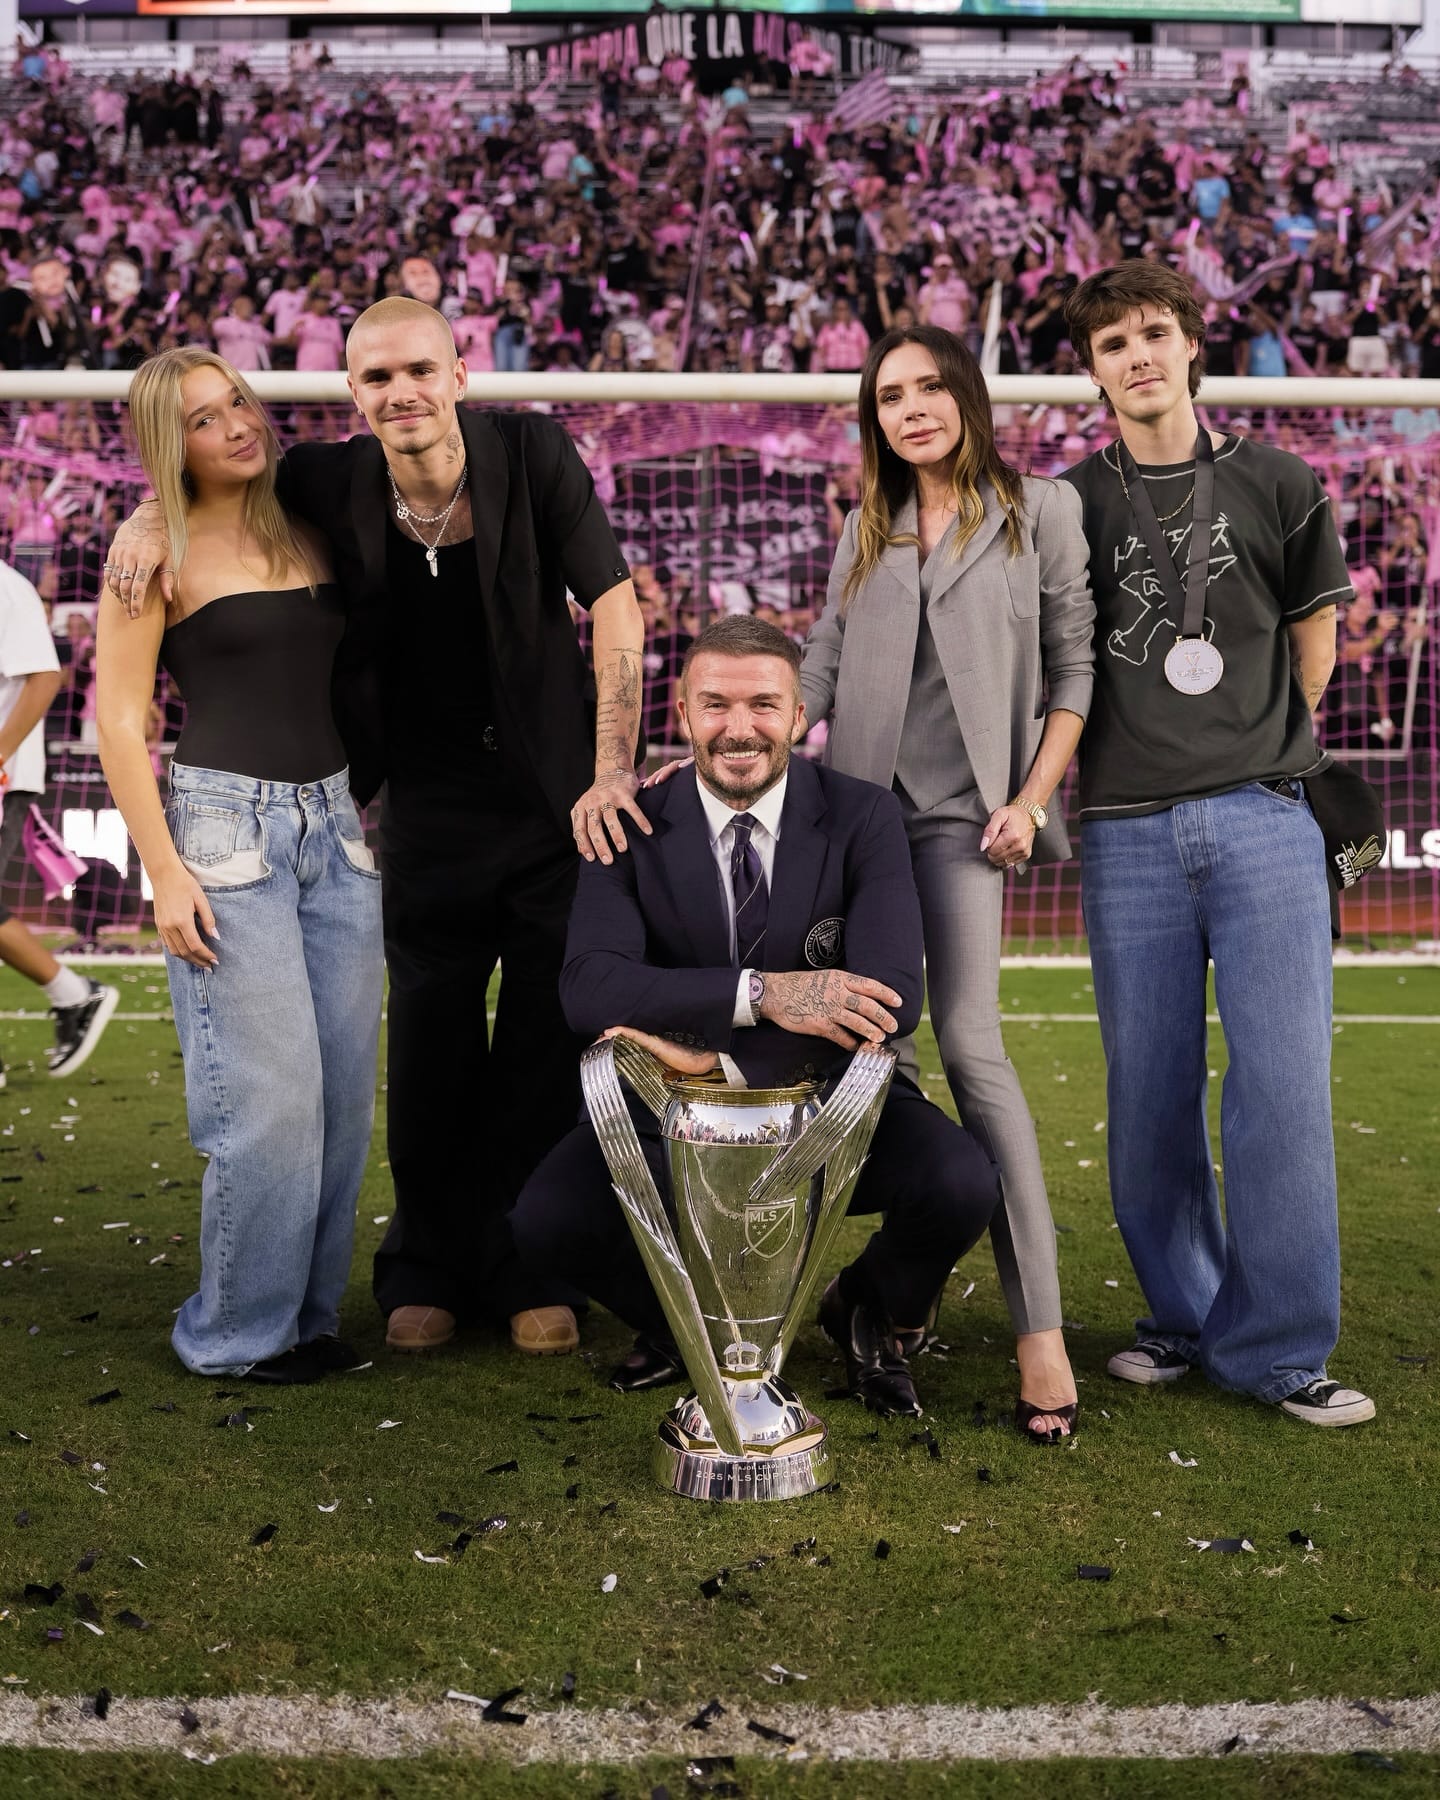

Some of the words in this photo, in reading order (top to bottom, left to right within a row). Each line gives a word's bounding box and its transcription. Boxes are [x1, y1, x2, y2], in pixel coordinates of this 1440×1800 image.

[645, 12, 698, 65] QUE
[705, 13, 745, 60] LA
[1379, 829, 1440, 869] LS
[750, 1210, 777, 1223] MLS
[696, 1470, 723, 1481] 2025
[727, 1473, 752, 1482] MLS
[756, 1472, 779, 1481] CUP
